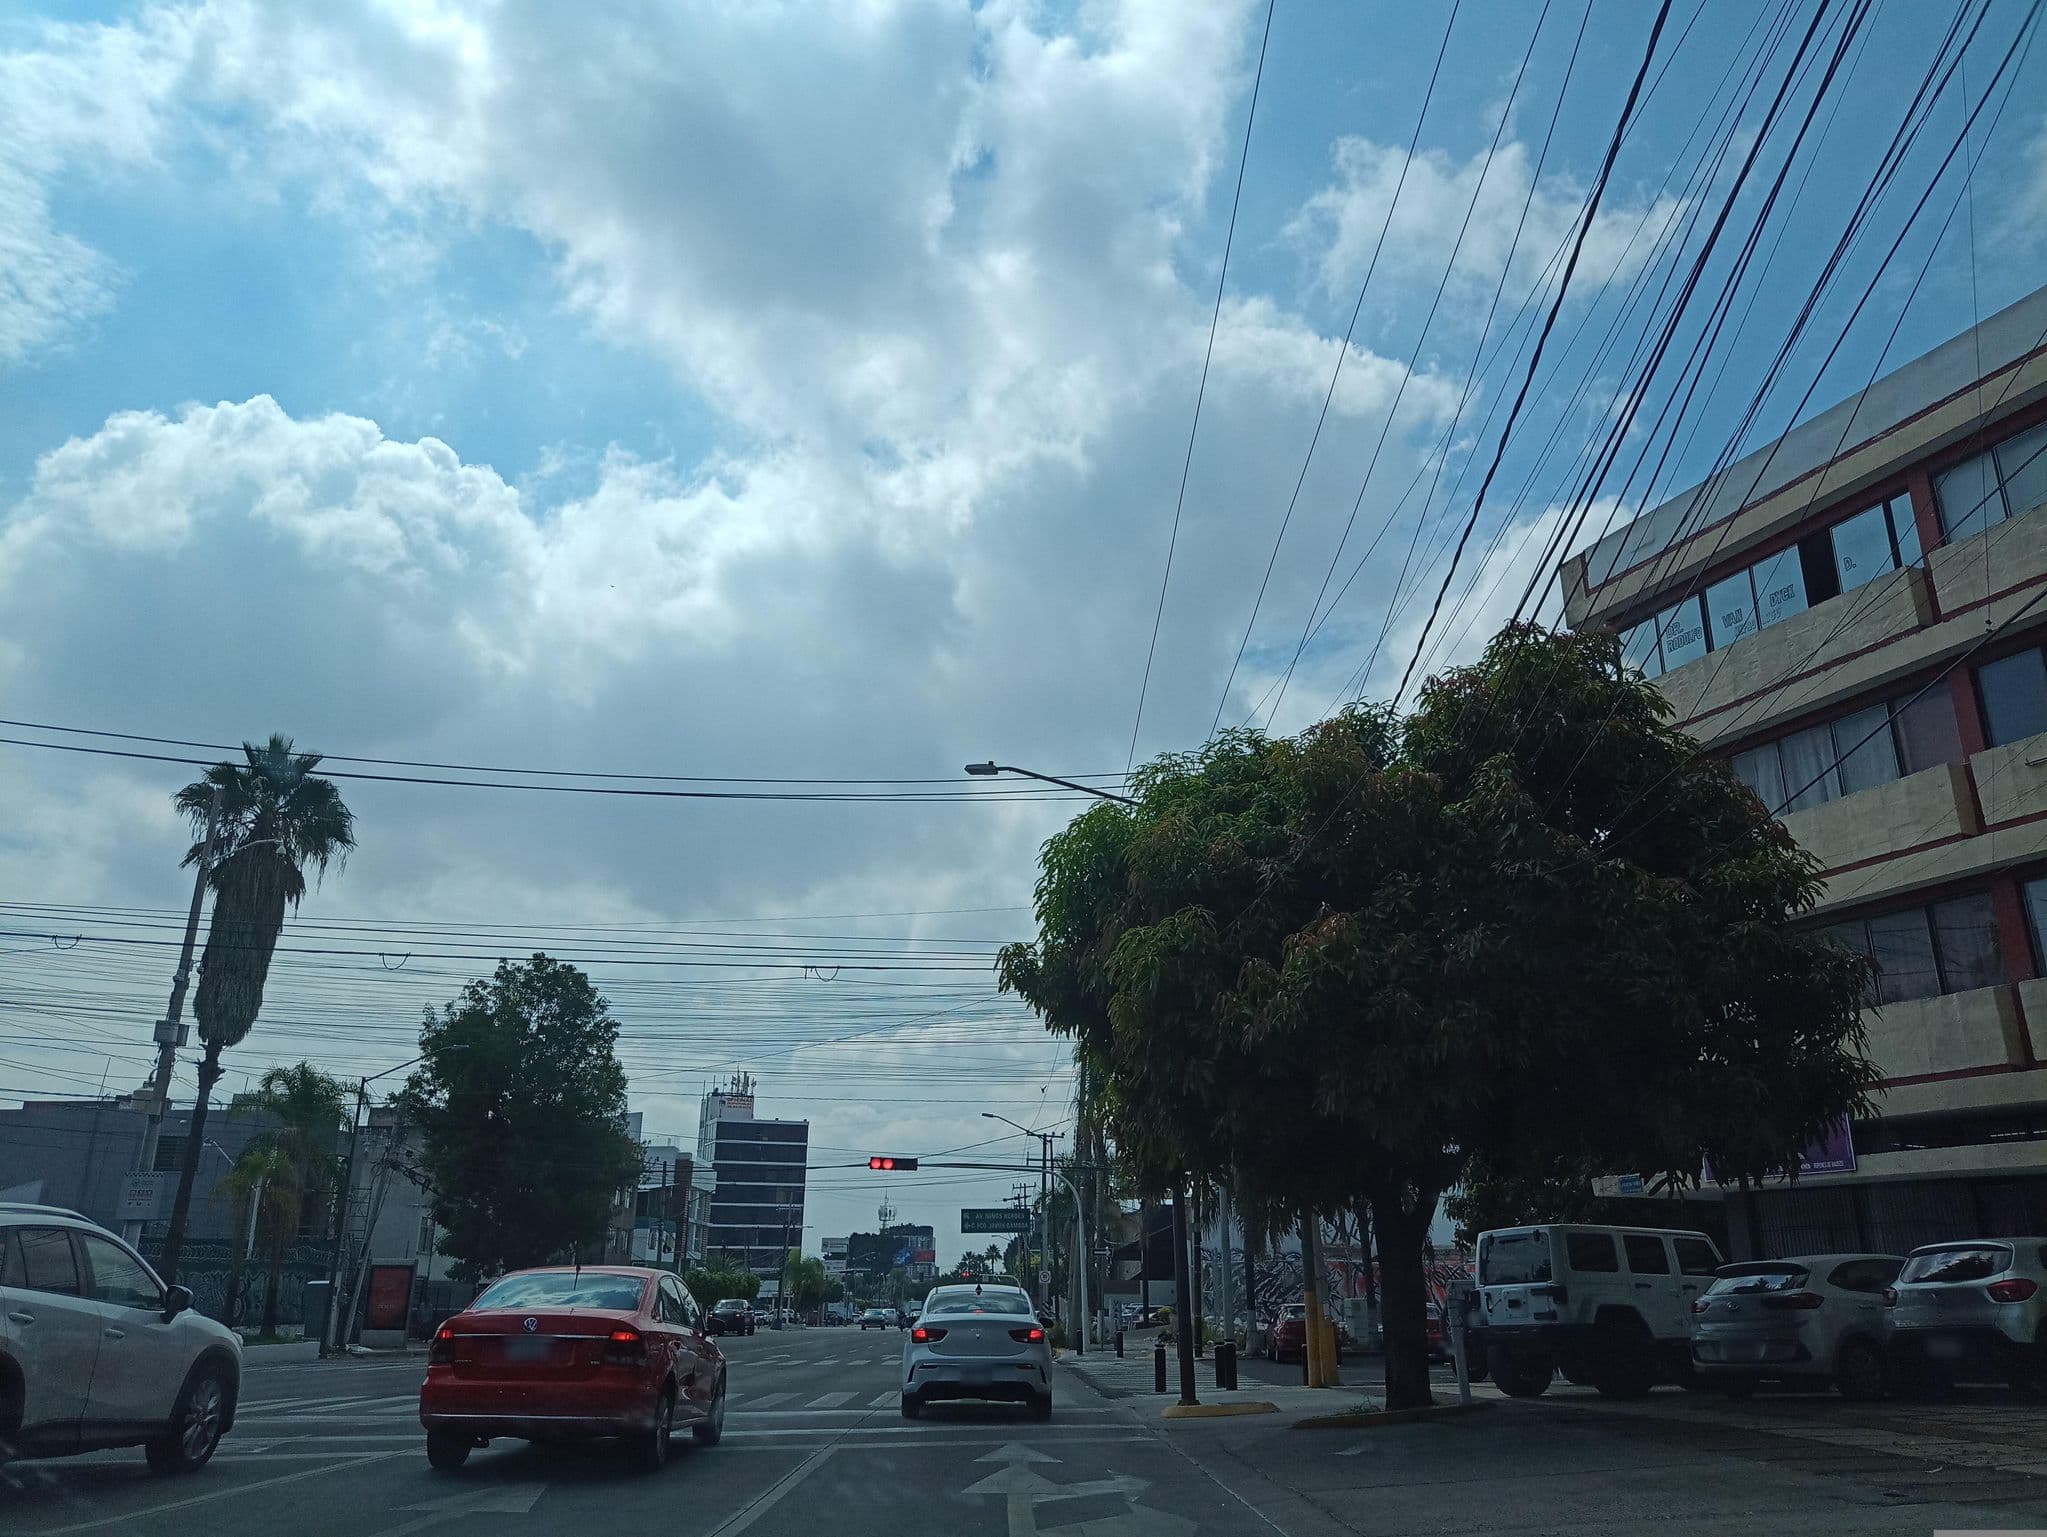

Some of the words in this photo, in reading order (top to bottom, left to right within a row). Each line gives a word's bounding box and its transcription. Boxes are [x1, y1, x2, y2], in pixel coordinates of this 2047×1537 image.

[1666, 626, 1703, 653] RODOLFO
[1722, 608, 1743, 628] VAN
[1769, 584, 1796, 607] DYCK
